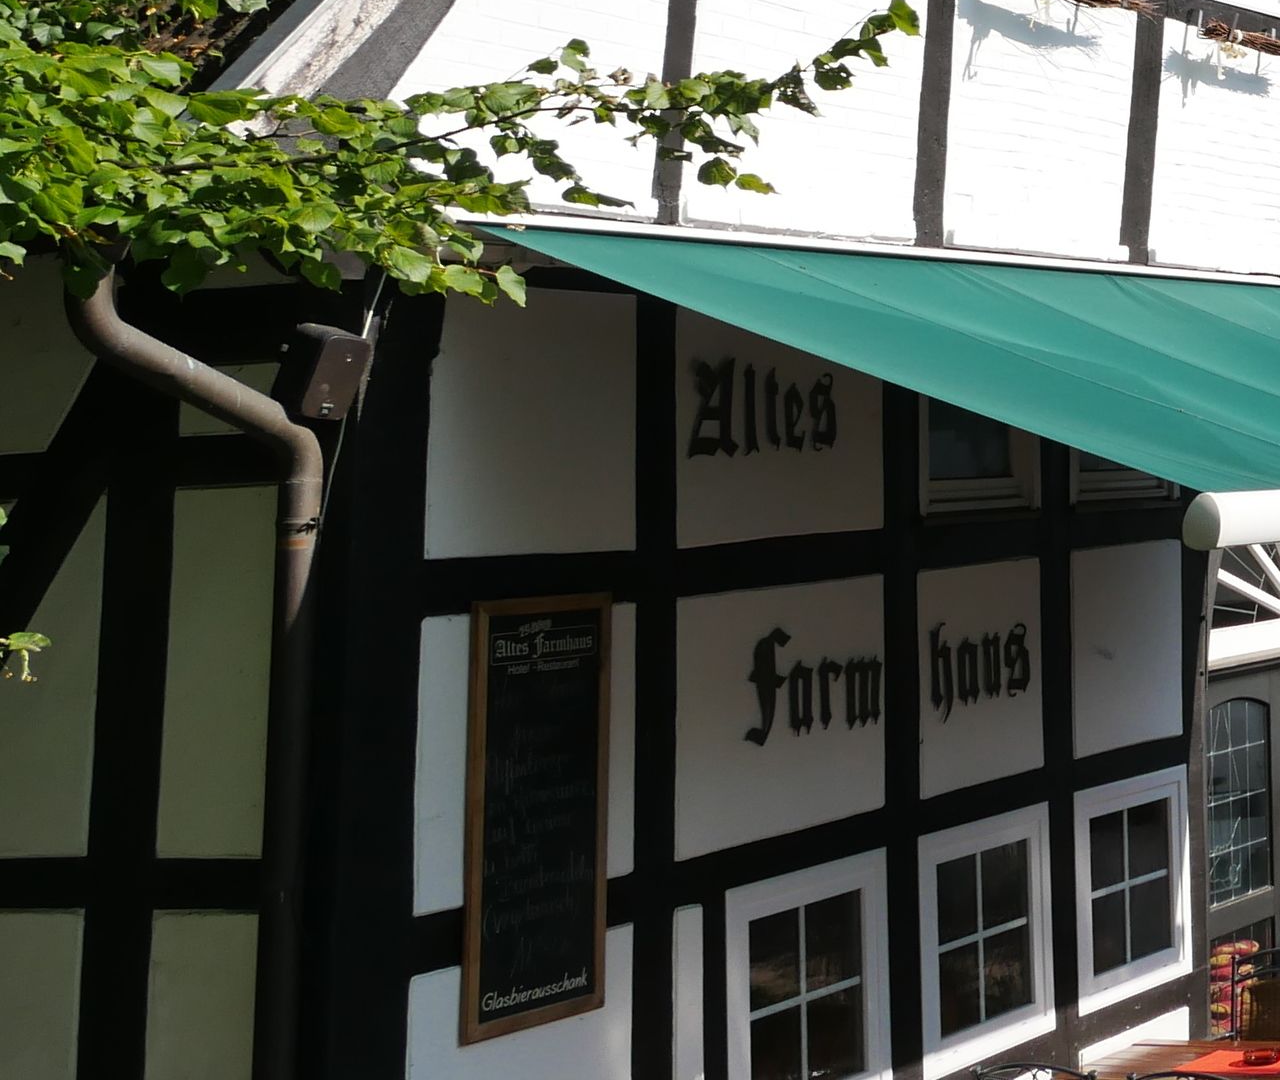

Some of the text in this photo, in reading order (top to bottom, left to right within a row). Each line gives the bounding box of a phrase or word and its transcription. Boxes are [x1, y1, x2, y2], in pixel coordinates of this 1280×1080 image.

[687, 357, 838, 460] Altes
[495, 633, 593, 658] Altes Farmhaus
[743, 621, 1032, 747] Farm haus
[481, 966, 588, 1012] Glasbierausschank
